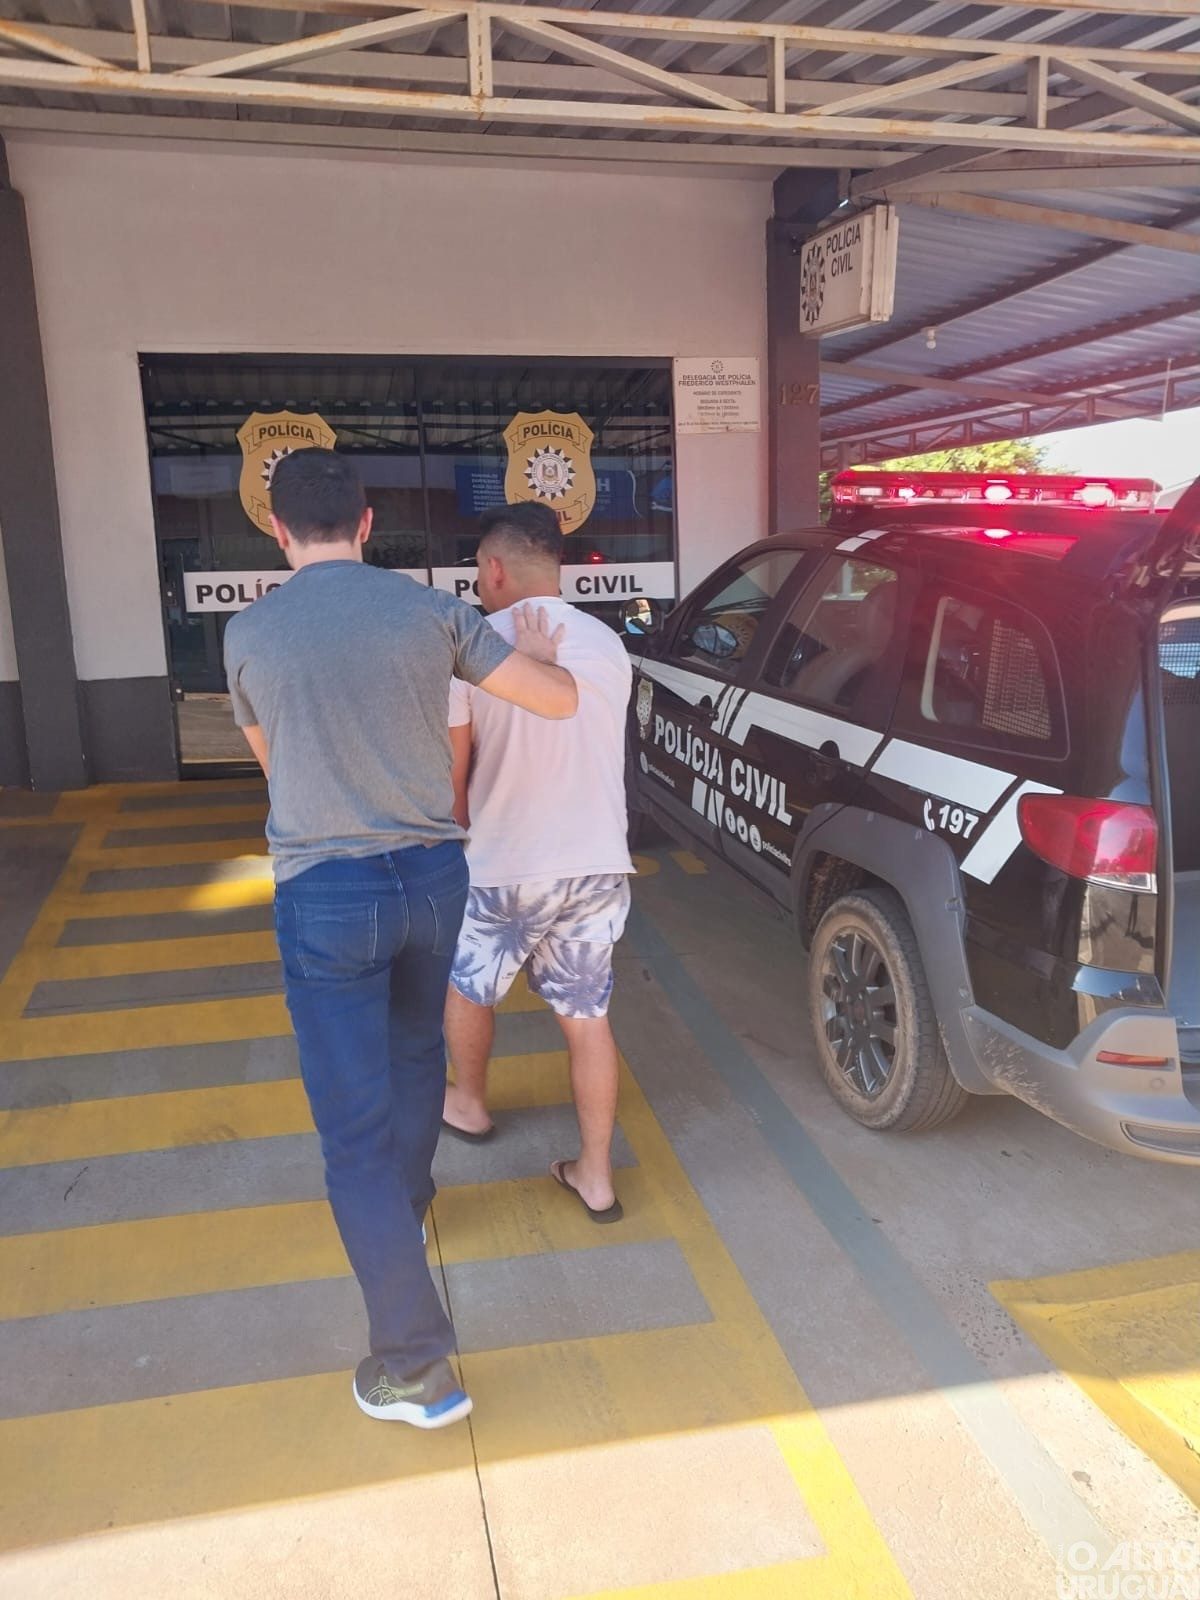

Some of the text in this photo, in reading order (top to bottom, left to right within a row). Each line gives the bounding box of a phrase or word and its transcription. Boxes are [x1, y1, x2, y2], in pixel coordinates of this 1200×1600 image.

[831, 253, 853, 277] CIVIL
[259, 421, 315, 441] POLÍCIA
[523, 420, 574, 439] POLÍCIA
[575, 575, 643, 595] CIVIL
[654, 714, 792, 826] POLÍCIA CIVIL
[939, 804, 979, 839] 197
